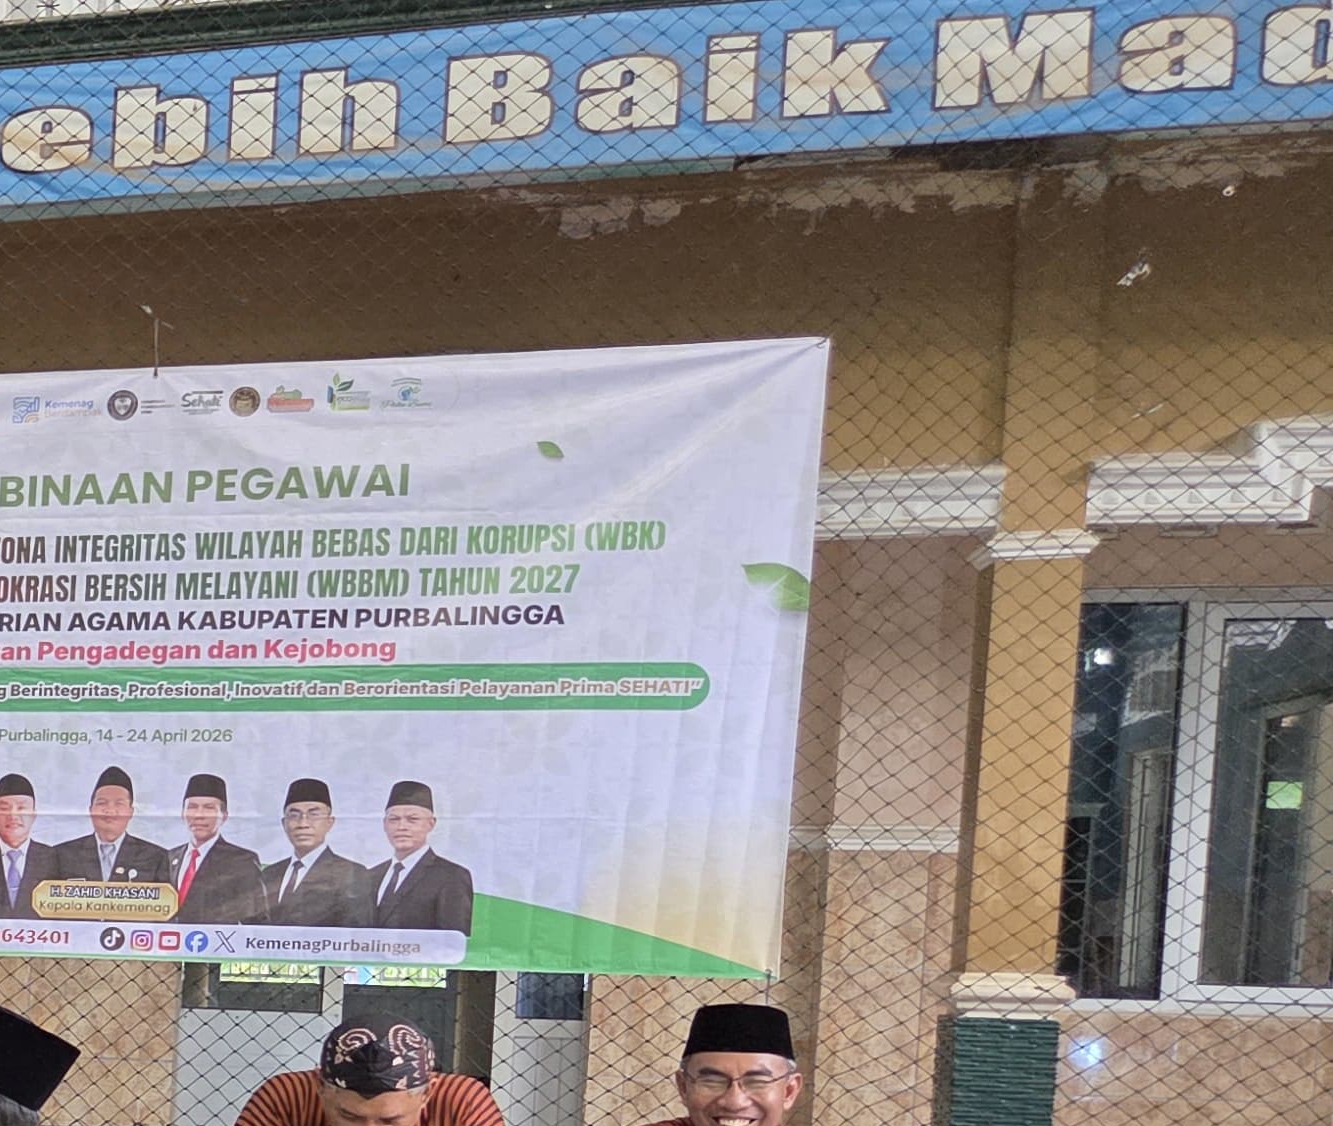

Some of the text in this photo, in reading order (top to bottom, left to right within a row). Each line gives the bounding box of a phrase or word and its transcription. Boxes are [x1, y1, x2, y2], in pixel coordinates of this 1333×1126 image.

[442, 28, 891, 146] Baik
[45, 400, 94, 410] Kemenag
[186, 463, 410, 503] PEGAWAI
[54, 533, 187, 564] INTEGRITAS
[195, 530, 303, 560] WILAYAH
[311, 527, 391, 558] BEBAS
[399, 526, 458, 556] DARI
[465, 523, 576, 555] KORUPSI
[584, 520, 667, 551] (WBK)
[84, 573, 167, 602] BERSIH
[175, 570, 298, 601] MELAYANI
[306, 567, 410, 599] (WBBM)
[419, 566, 501, 597] TAHUN
[508, 563, 581, 594] 2027
[67, 611, 171, 632] AGAMA
[178, 608, 348, 630] KABUPATEN
[354, 604, 565, 629] PURBALINGGA
[37, 640, 201, 665] Pengadegan
[207, 640, 257, 660] dan
[263, 637, 397, 664] Kejobong
[10, 683, 125, 699] Berintegritas,
[128, 682, 232, 699] Profesional,
[235, 682, 303, 697] Inovatif
[305, 682, 340, 697] dan
[343, 681, 455, 696] Berorientasi
[459, 680, 556, 698] Pelayanan
[559, 679, 616, 695] Prima
[619, 678, 702, 695] SEHATI”
[97, 729, 114, 742] 14
[126, 729, 148, 742] 24
[151, 728, 188, 745] April
[191, 728, 233, 743] 2026
[50, 885, 160, 899] H. ZAHID KHASANI
[39, 900, 171, 915] Kepala Kankemenag
[245, 936, 421, 955] KemenagPurbalingga
